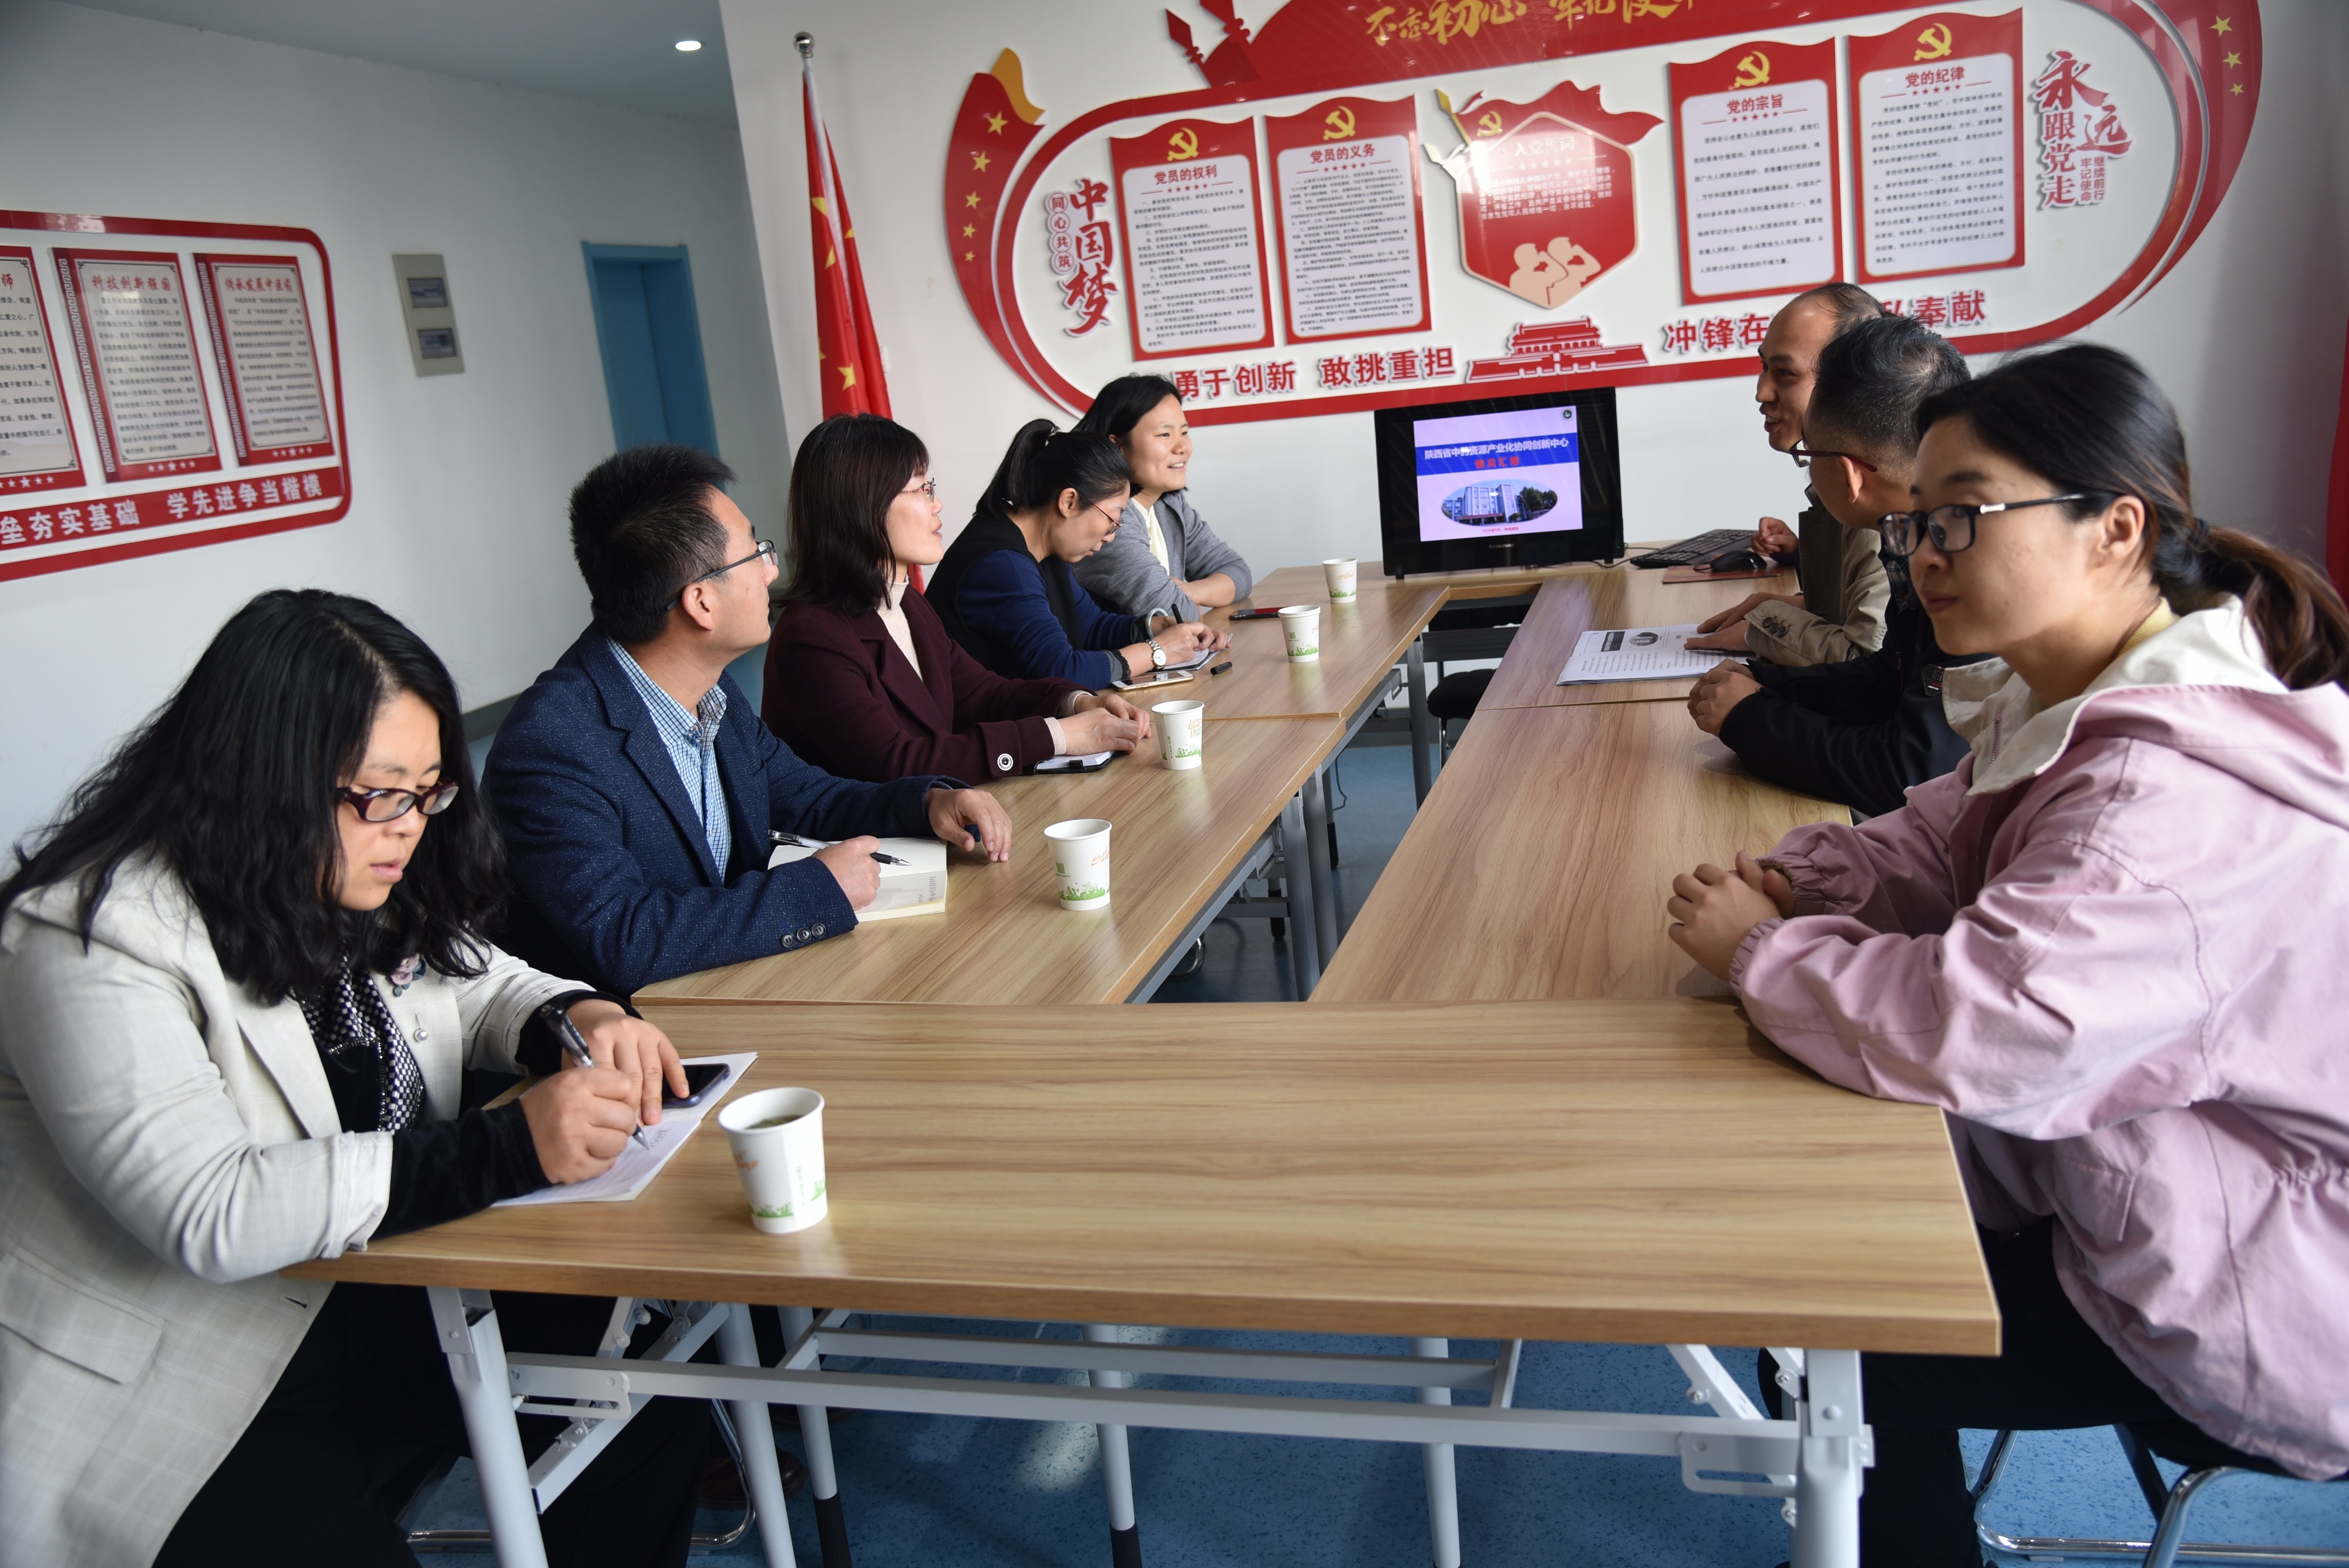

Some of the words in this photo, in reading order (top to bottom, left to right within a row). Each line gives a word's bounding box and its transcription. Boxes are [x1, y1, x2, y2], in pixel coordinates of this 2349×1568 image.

[1549, 0, 1694, 30] 牢记使
[1906, 66, 1965, 88] 党的纪律
[1727, 93, 1783, 115] 党的宗旨
[1310, 144, 1375, 164] 党员的义务
[1155, 164, 1217, 185] 党员的权利
[1052, 197, 1072, 268] 同心共筑
[1061, 179, 1118, 335] 中国梦
[92, 274, 171, 291] 科技创新强国
[1176, 360, 1295, 397] 勇于创新
[1322, 346, 1455, 388] 敢挑重担
[1, 499, 140, 545] 垒夯实基础
[167, 474, 322, 520] 学先进争当楷模
